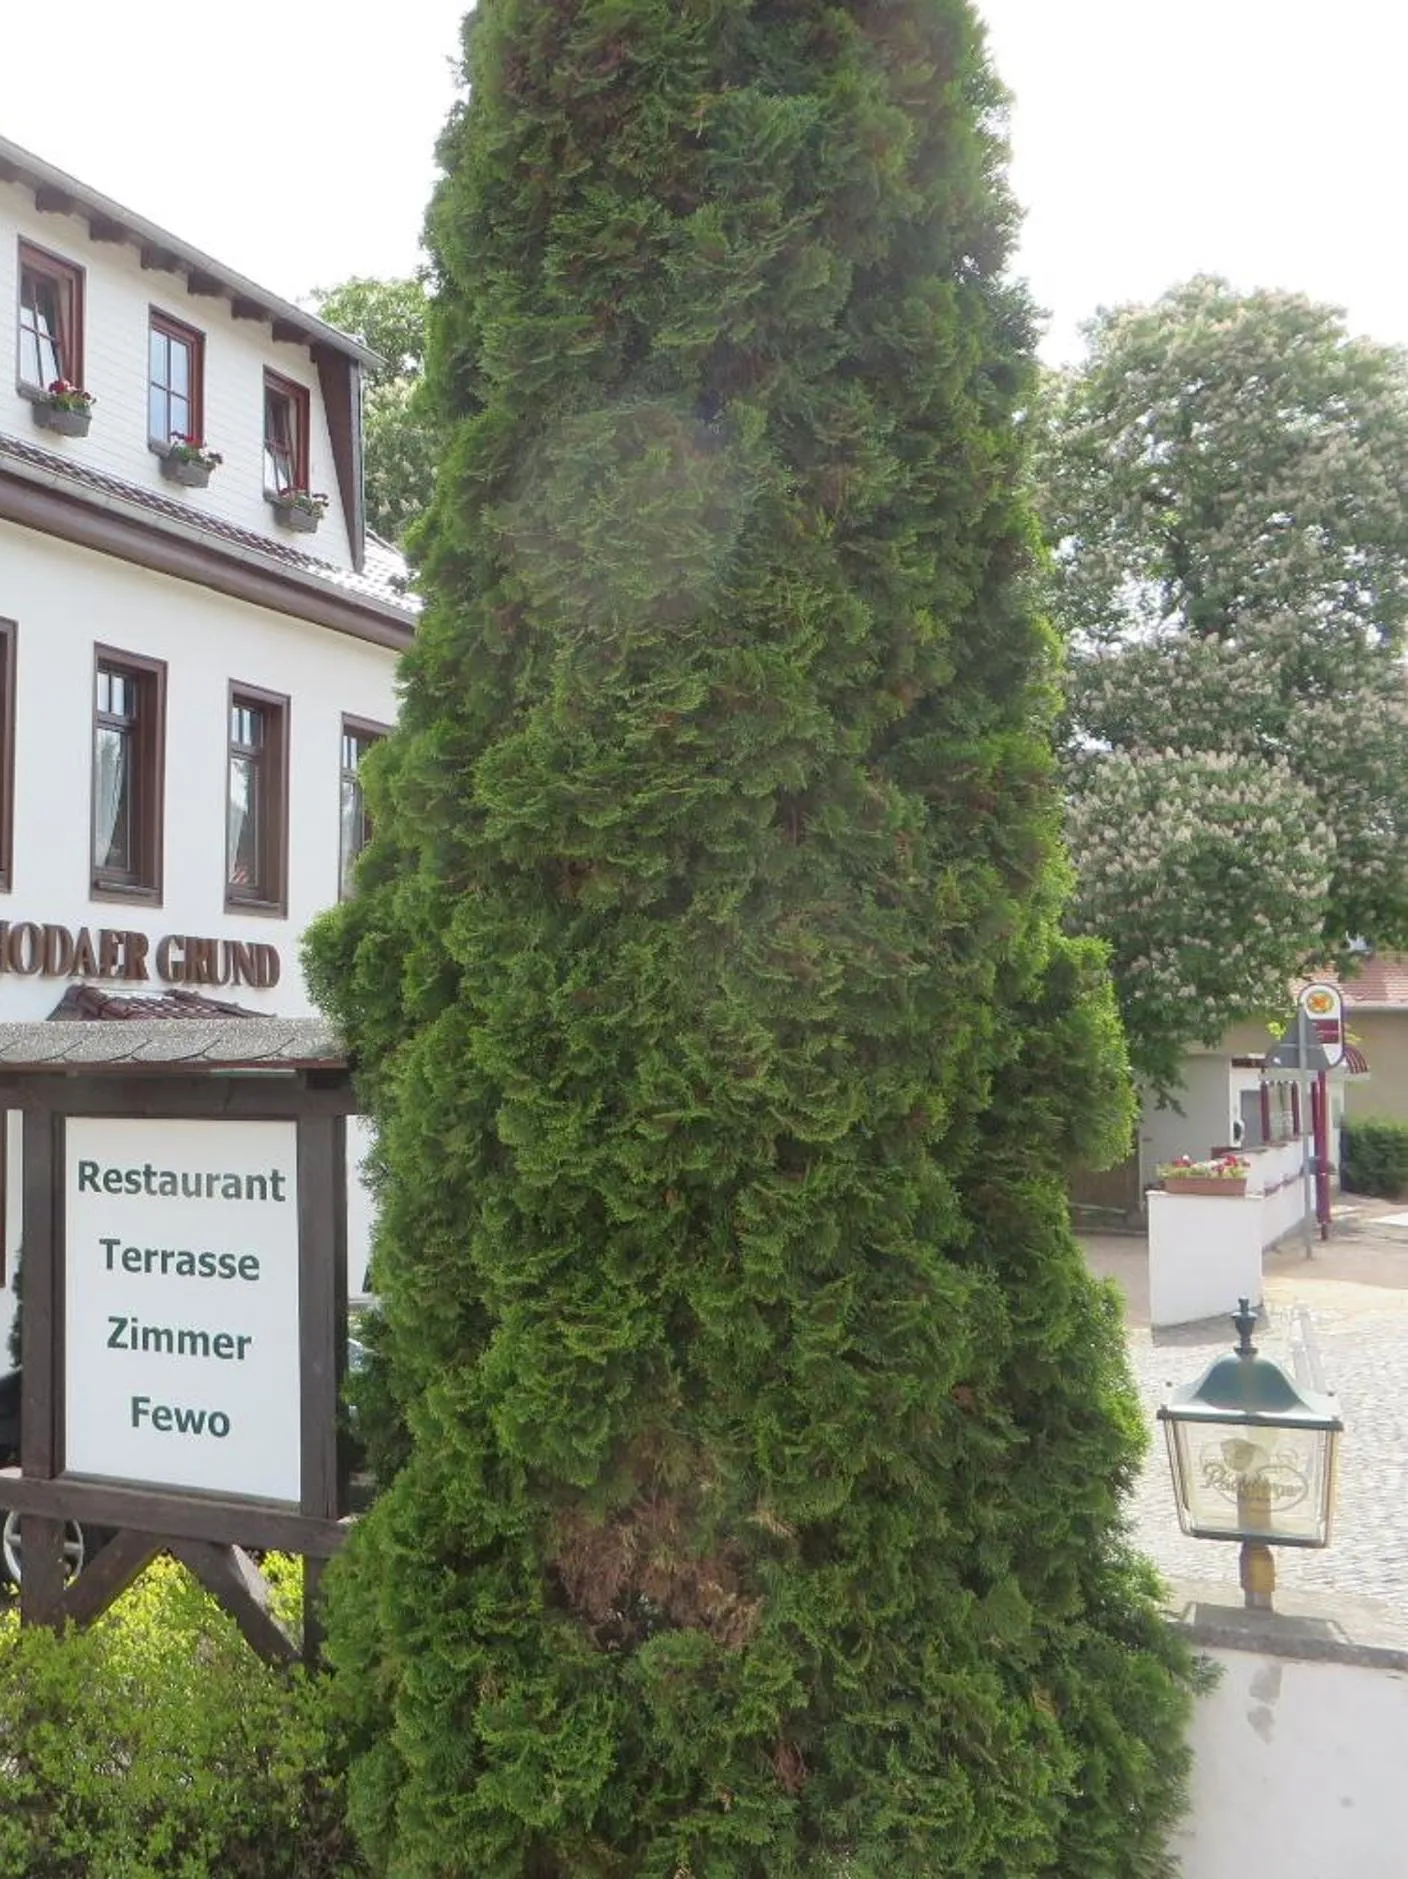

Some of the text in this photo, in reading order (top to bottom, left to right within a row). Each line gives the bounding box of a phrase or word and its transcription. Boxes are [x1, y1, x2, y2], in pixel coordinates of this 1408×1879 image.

[156, 933, 281, 988] GRUND
[77, 1160, 287, 1202] Restaurant
[99, 1238, 261, 1281] Terrasse
[107, 1316, 253, 1360] Zimmer
[130, 1396, 231, 1438] Fewo
